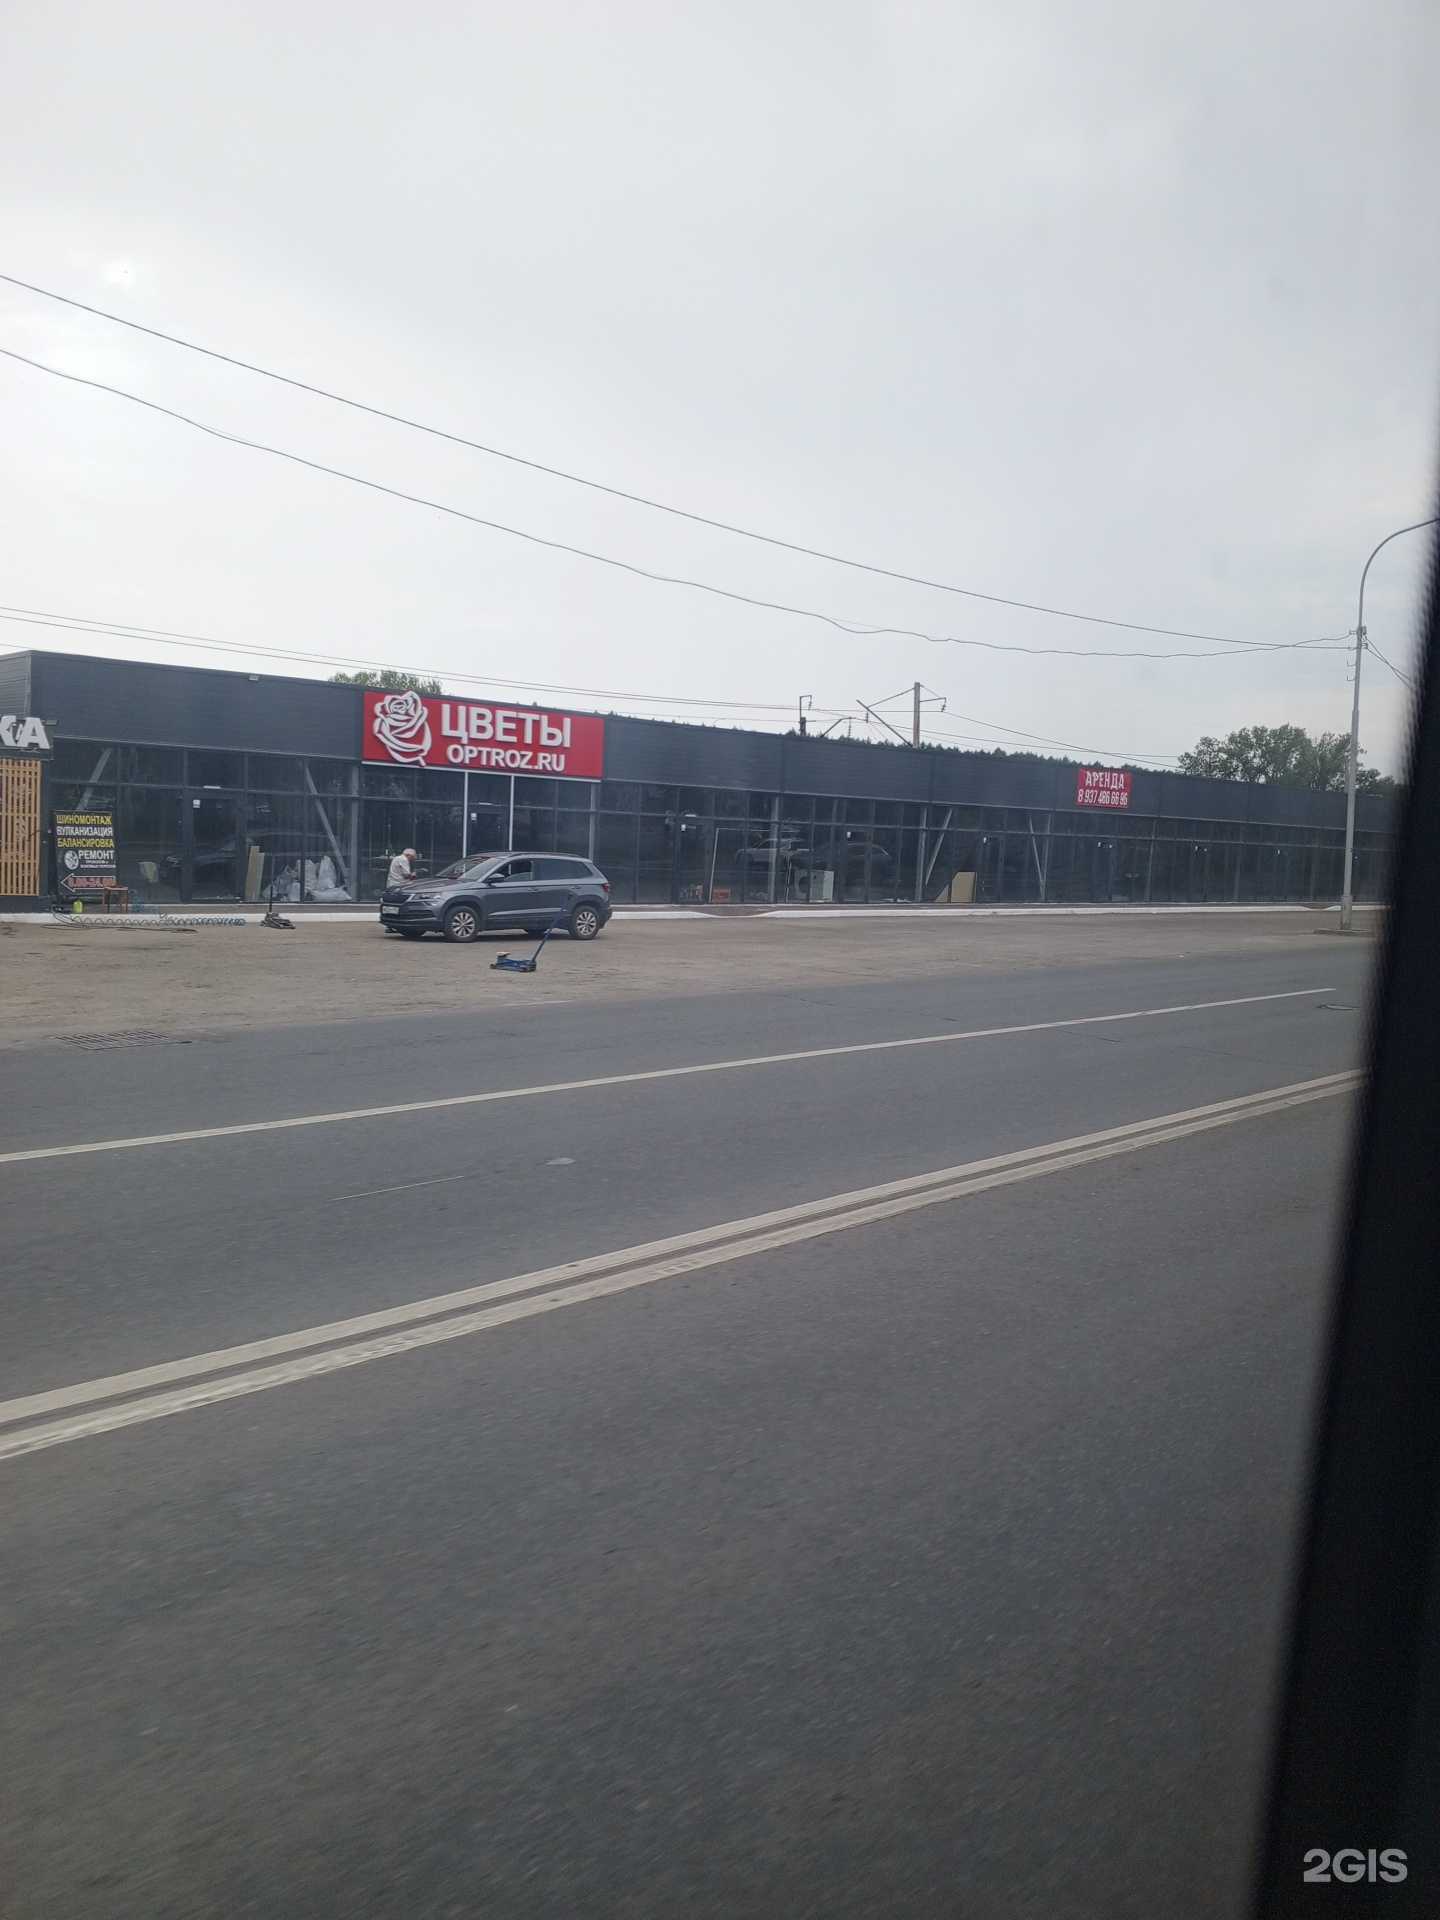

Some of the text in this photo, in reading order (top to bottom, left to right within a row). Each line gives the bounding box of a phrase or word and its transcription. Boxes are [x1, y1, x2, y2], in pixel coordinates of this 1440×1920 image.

[441, 703, 571, 747] ЦВЕТЫ
[447, 744, 565, 772] OPTROZ.RU
[1085, 771, 1125, 790] АРЕНДА
[1078, 789, 1084, 803] 8
[56, 815, 112, 825] ШИНОМОНТАЖ
[56, 826, 113, 837] ВУЛКАНИЗАЦИЯ
[57, 838, 115, 848] БАЛАНСИРОВКА
[78, 850, 114, 860] РЕМОНТ
